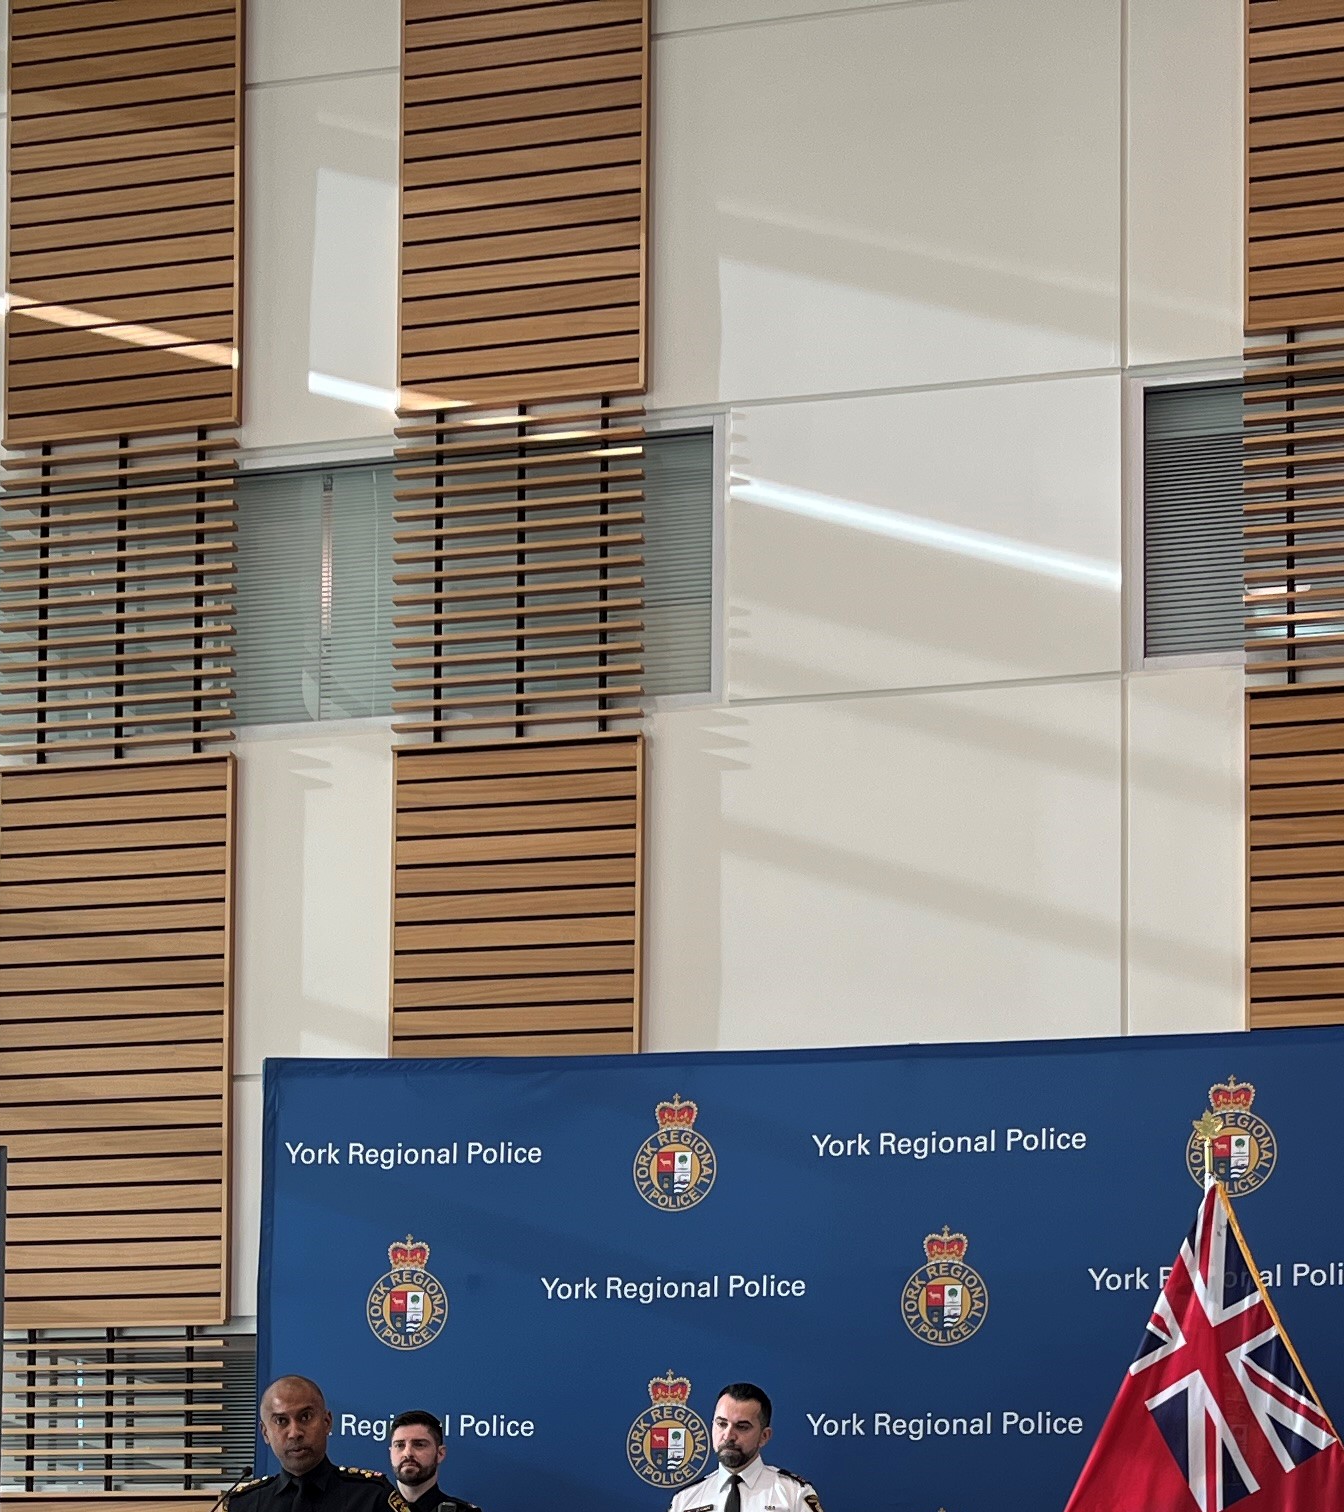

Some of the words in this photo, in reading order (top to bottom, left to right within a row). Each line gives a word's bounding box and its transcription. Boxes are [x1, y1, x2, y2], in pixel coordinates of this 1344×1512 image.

[285, 1143, 340, 1165] York
[349, 1142, 458, 1170] Regional
[468, 1142, 542, 1164] Police
[657, 1130, 712, 1184] REGIONAL
[812, 1133, 871, 1157] York
[880, 1129, 996, 1160] Regional
[1007, 1128, 1087, 1152] Police
[1220, 1113, 1274, 1170] EGIONAL
[637, 1145, 657, 1190] YORK
[650, 1187, 700, 1208] POLICE
[541, 1278, 598, 1300] York
[607, 1276, 719, 1304] Regional
[730, 1275, 806, 1298] Police
[926, 1262, 984, 1318] REGIONAL
[1088, 1267, 1150, 1291] York
[370, 1285, 390, 1329] YORK
[390, 1271, 444, 1323] REGIONAL
[905, 1277, 926, 1324] YORK
[382, 1327, 432, 1347] POLICE
[918, 1321, 971, 1343] POLICE
[460, 1414, 535, 1437] Police
[651, 1406, 706, 1460] REGIONAL
[807, 1413, 865, 1436] York
[875, 1412, 992, 1441] Regional
[1003, 1411, 1083, 1435] Police
[631, 1421, 651, 1467] YORK
[644, 1464, 694, 1485] POLICE
